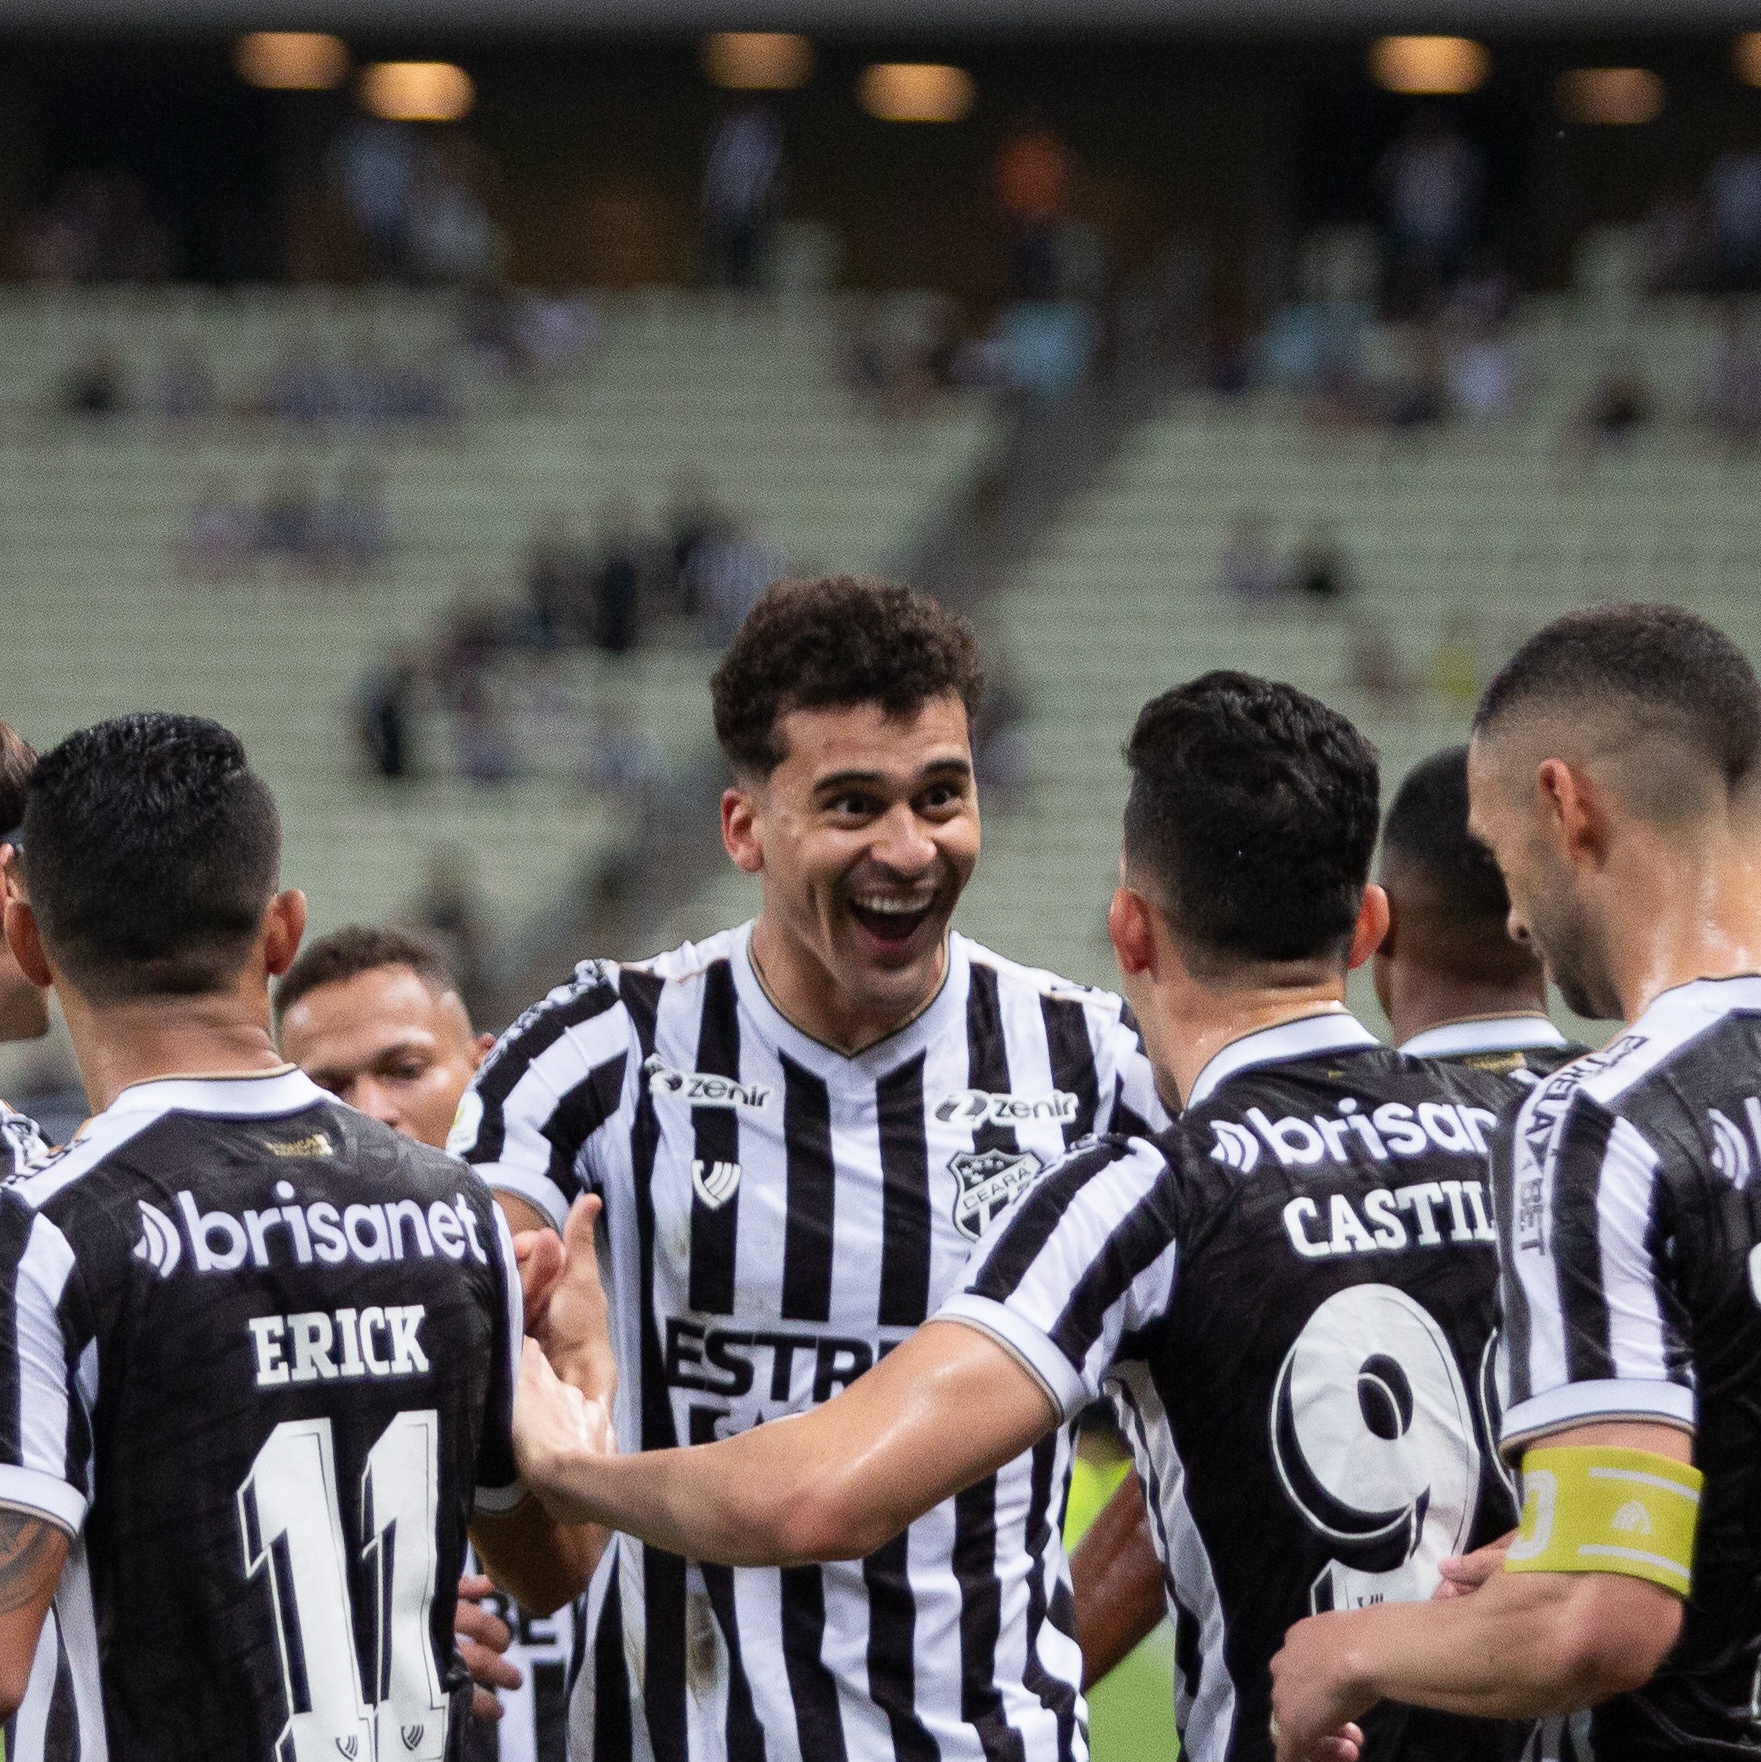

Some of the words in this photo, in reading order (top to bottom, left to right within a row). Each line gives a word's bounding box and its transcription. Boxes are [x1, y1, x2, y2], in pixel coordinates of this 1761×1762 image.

[688, 1079, 771, 1107] zenir
[993, 1093, 1075, 1118] zenir
[176, 1180, 488, 1271] brisanet
[248, 1305, 430, 1386] ERICK
[665, 1316, 904, 1402] ESTR
[1269, 1283, 1521, 1616] 9
